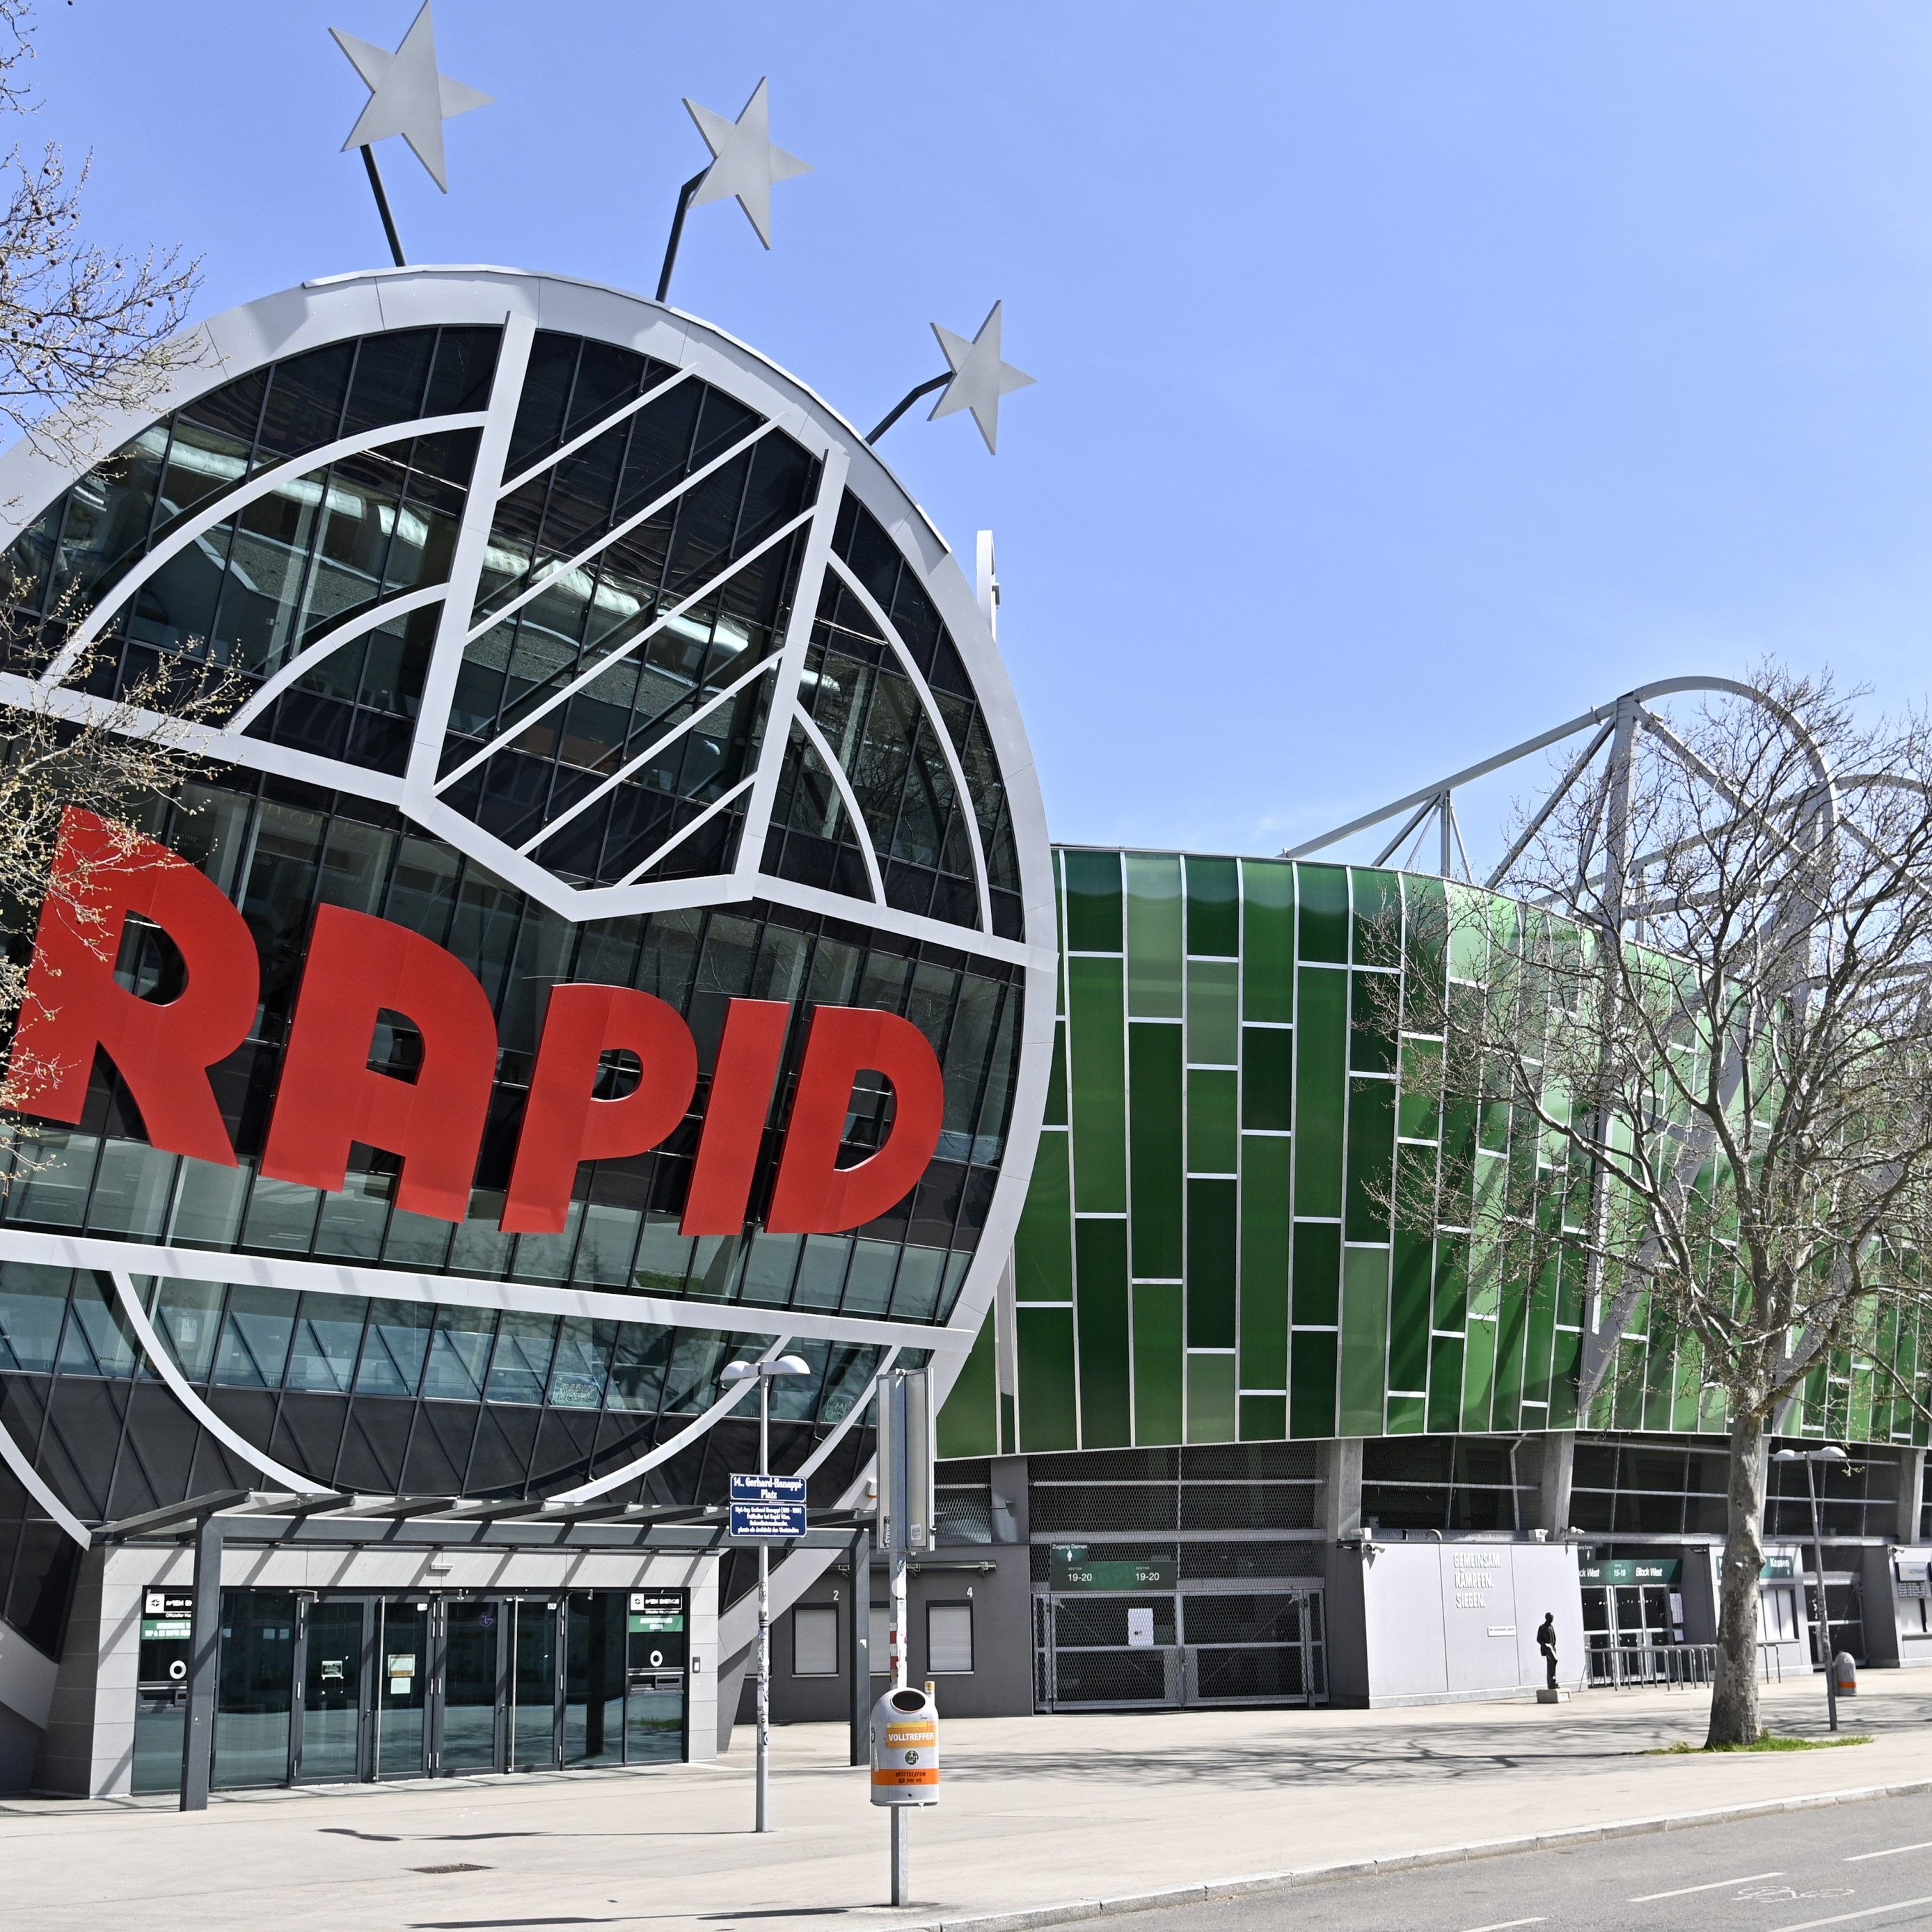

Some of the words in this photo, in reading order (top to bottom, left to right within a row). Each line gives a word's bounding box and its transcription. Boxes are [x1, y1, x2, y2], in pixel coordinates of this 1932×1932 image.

[6, 805, 944, 1236] RAPID
[745, 1477, 803, 1491] Gerhard-Hanappi-
[761, 1489, 777, 1499] Platz
[1454, 1552, 1502, 1569] GEMEINSAM.
[1770, 1558, 1789, 1567] Kassen
[1068, 1573, 1092, 1581] 19-20
[1136, 1572, 1159, 1581] 19-20
[1636, 1567, 1649, 1576] Block
[1650, 1567, 1663, 1576] West
[1455, 1569, 1494, 1588] KÄMPFEN.
[833, 1590, 839, 1601] 2
[967, 1586, 973, 1598] 4
[1456, 1592, 1487, 1608] SIEGEN.
[888, 1732, 934, 1742] VOLLTREFFER
